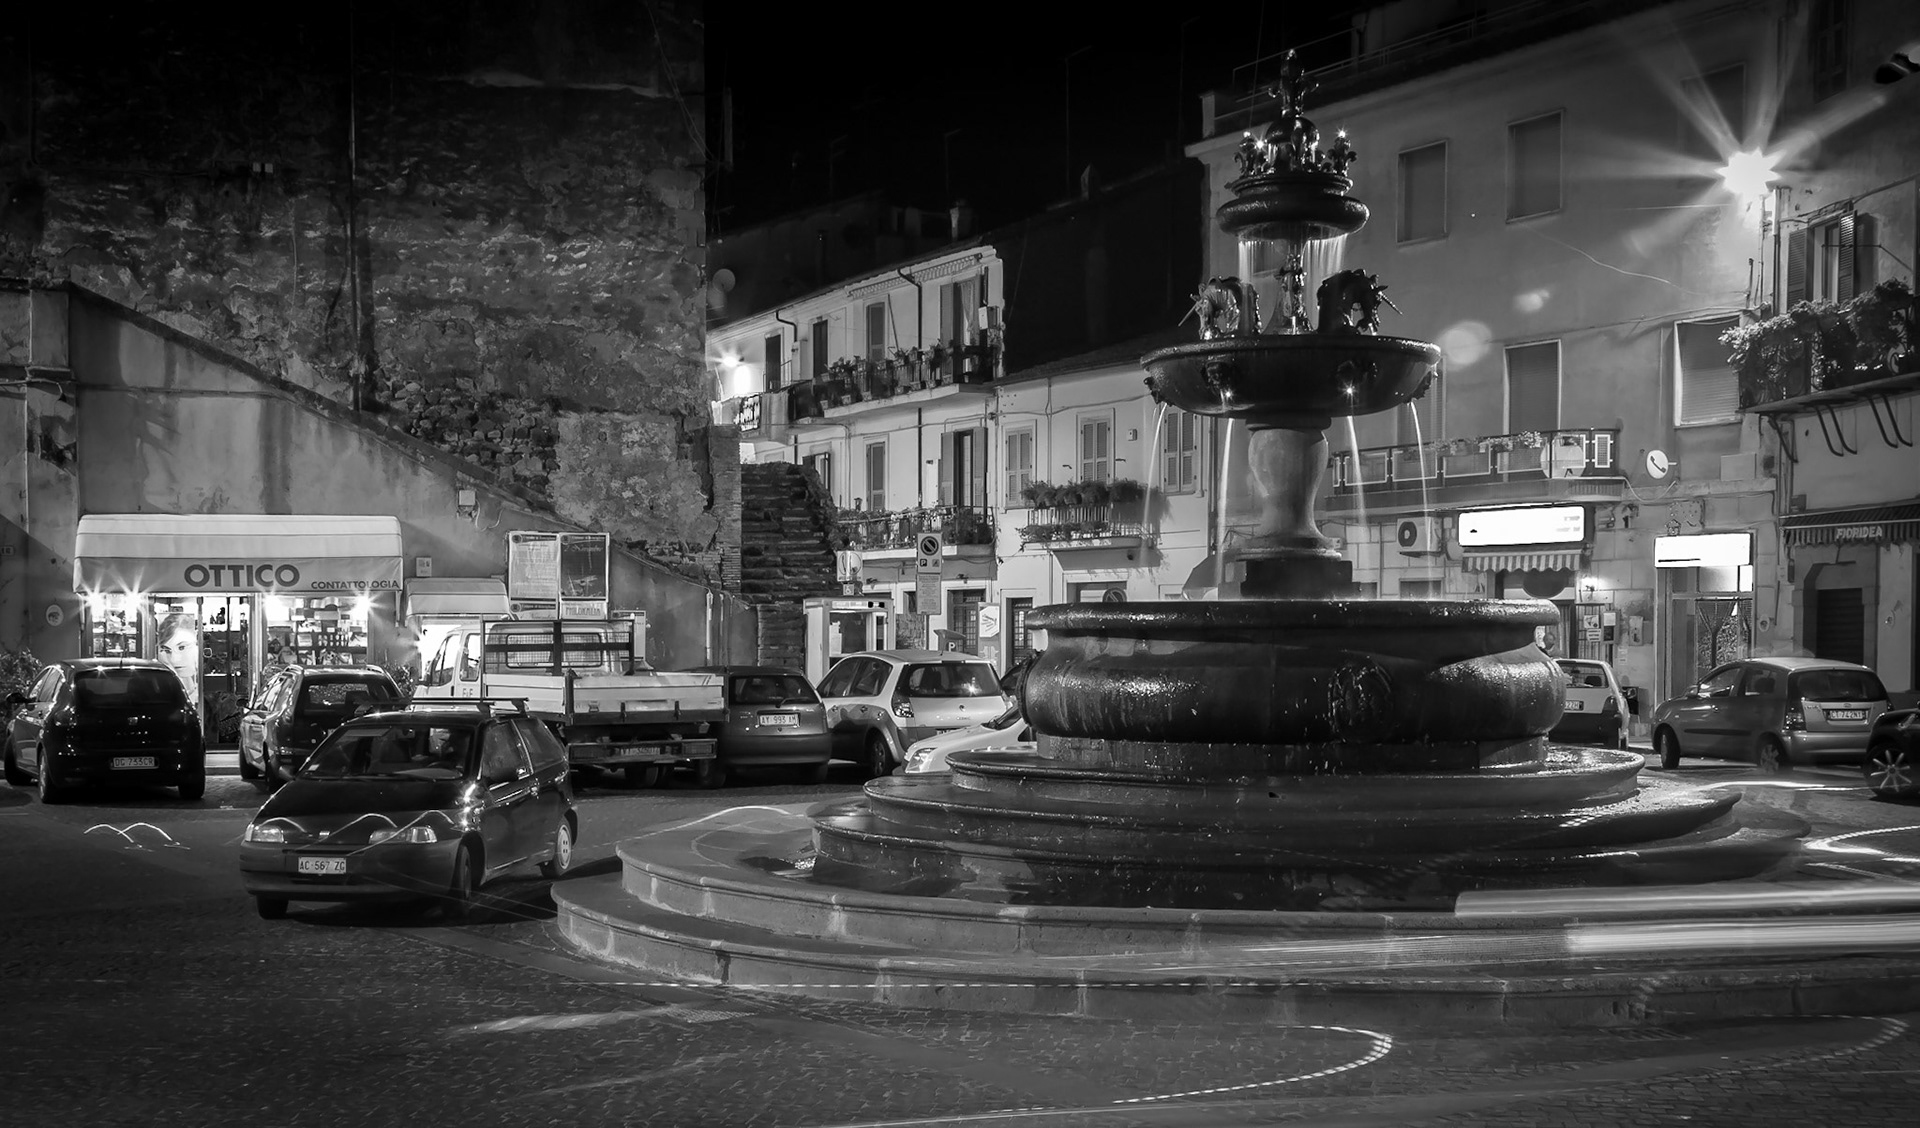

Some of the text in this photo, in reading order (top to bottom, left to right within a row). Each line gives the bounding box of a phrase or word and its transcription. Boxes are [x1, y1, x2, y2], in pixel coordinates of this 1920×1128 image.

[184, 564, 300, 587] OTTICO
[311, 580, 400, 590] CONTATTOLOGIA
[948, 642, 956, 652] P
[299, 861, 345, 871] AC 567 ZG
